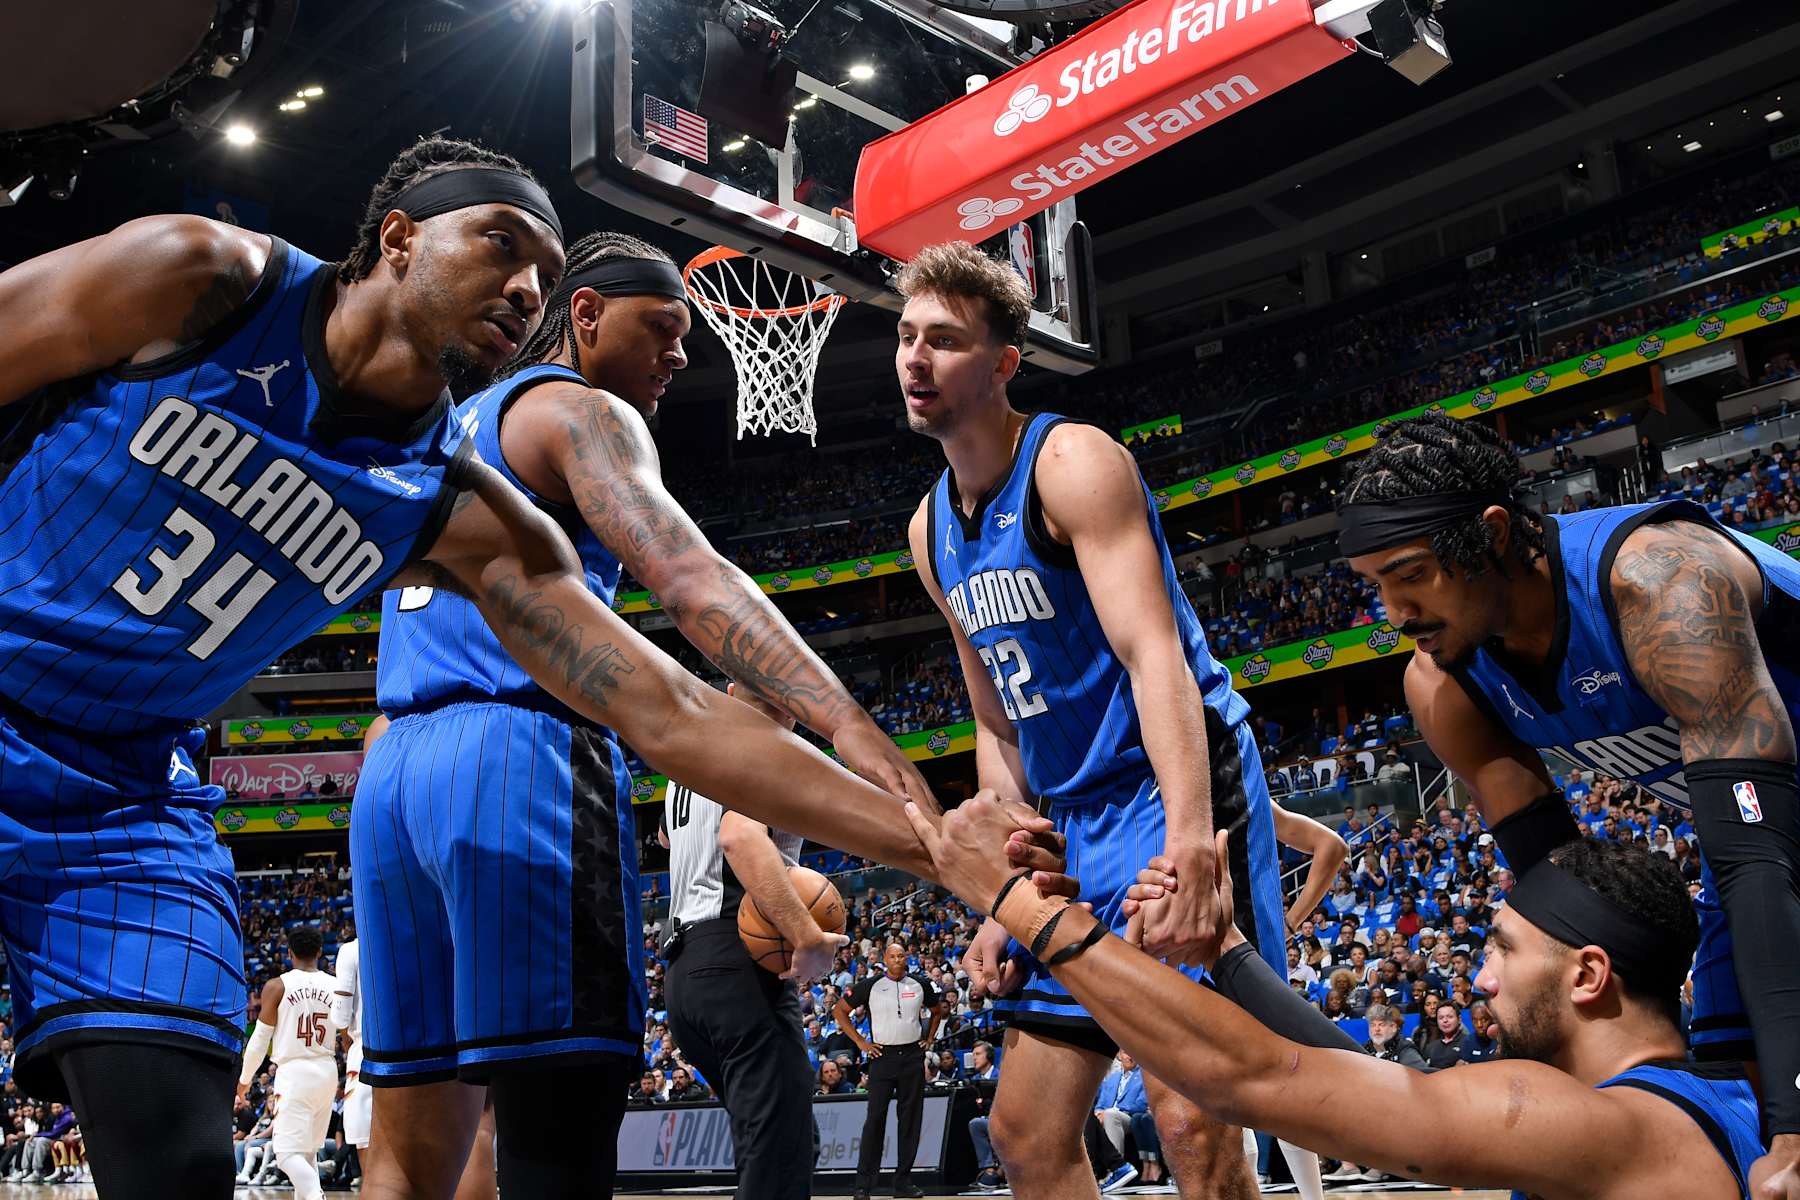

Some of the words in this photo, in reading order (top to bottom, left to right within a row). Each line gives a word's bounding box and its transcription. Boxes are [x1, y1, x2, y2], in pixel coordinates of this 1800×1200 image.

[1757, 301, 1788, 318] Starry
[1697, 319, 1726, 337] Starry
[1637, 339, 1665, 355] Starry
[1581, 357, 1607, 373] Starry
[1524, 375, 1551, 390] Starry
[128, 396, 384, 605] ORLANDO
[1774, 533, 1800, 552] Star
[112, 507, 278, 660] 34
[946, 568, 1055, 638] RLANDO
[1368, 630, 1399, 648] Starry
[1303, 646, 1333, 664] Starry
[1241, 660, 1271, 678] Starry
[673, 784, 692, 830] 10
[296, 1012, 329, 1047] 45
[672, 1110, 735, 1166] PLAY
[818, 1138, 846, 1166] gle
